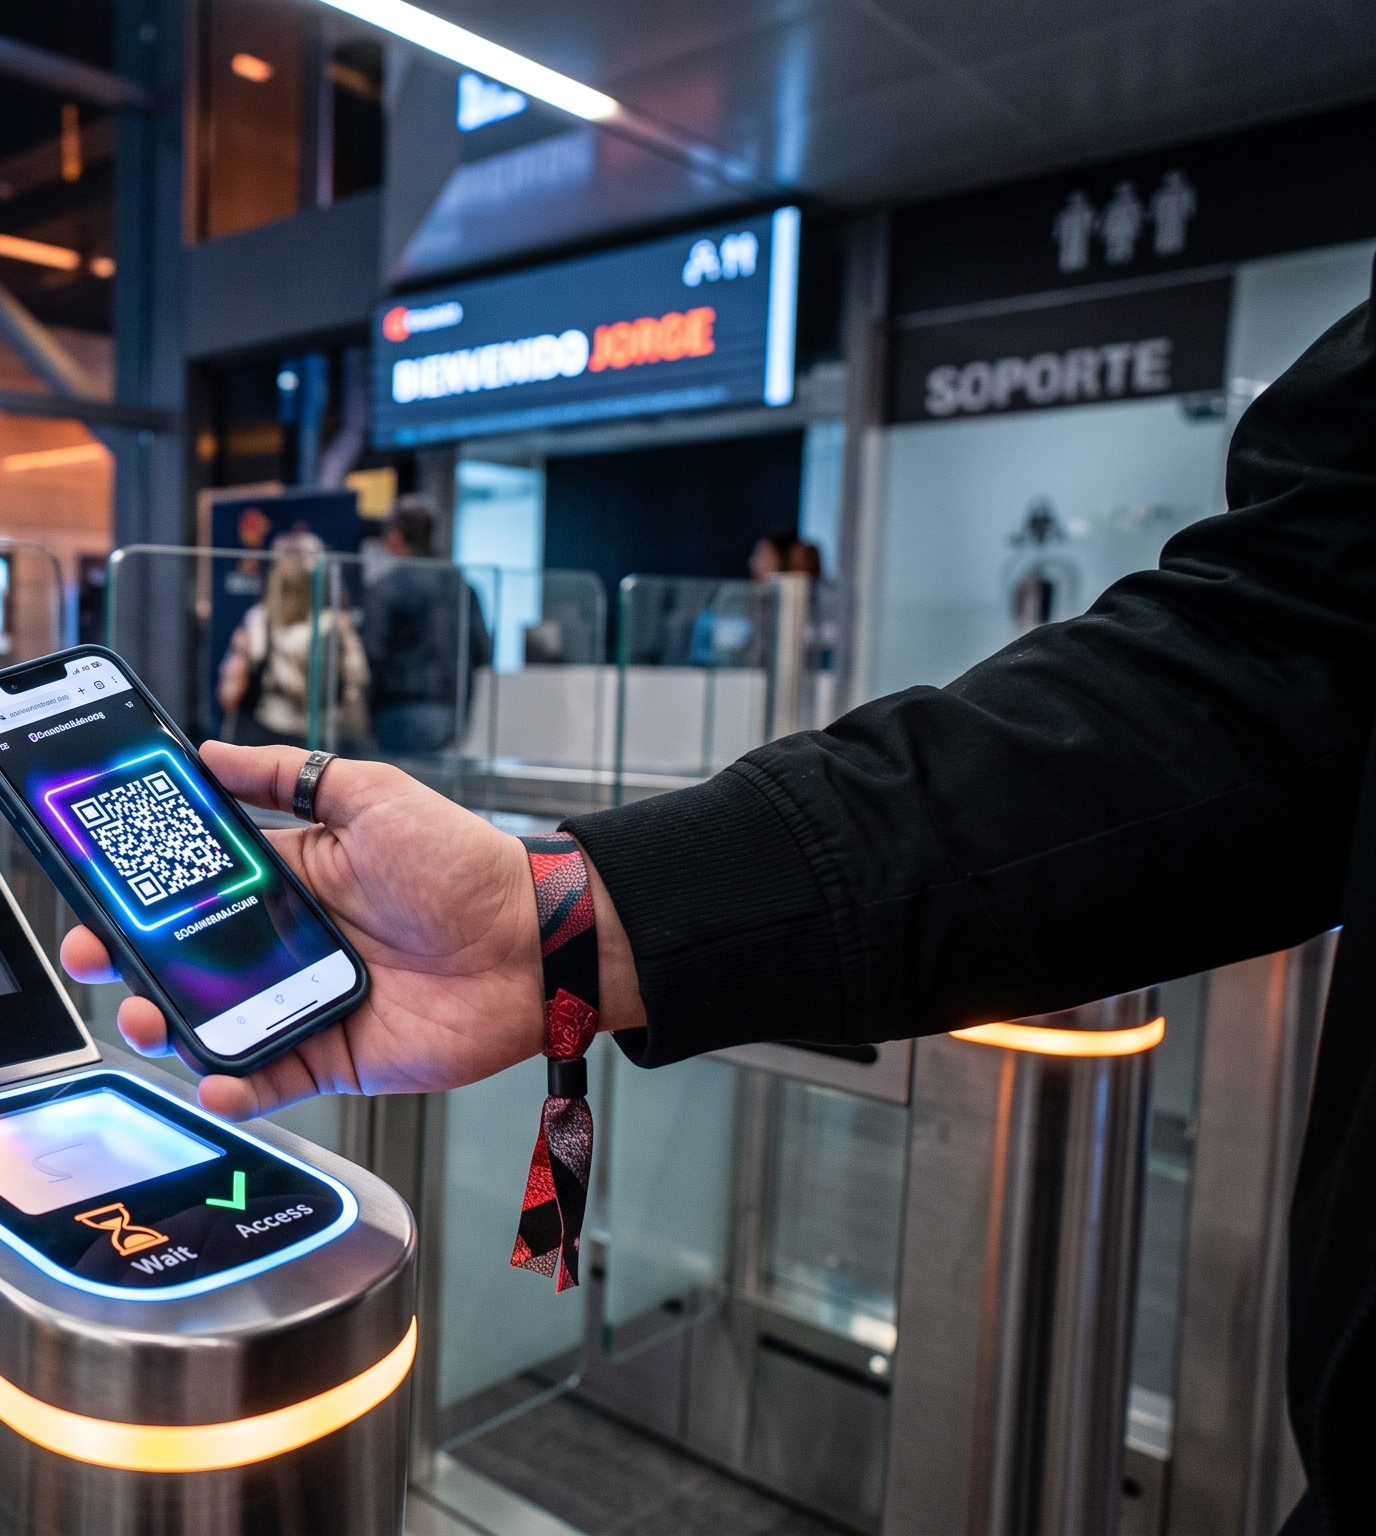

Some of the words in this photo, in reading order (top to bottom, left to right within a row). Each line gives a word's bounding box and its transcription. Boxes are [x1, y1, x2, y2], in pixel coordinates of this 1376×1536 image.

[393, 329, 589, 403] BIENVENIDO
[589, 307, 716, 372] JORGE
[926, 337, 1171, 416] SOPORTE
[235, 1204, 314, 1238] Access
[130, 1246, 198, 1274] Wait
